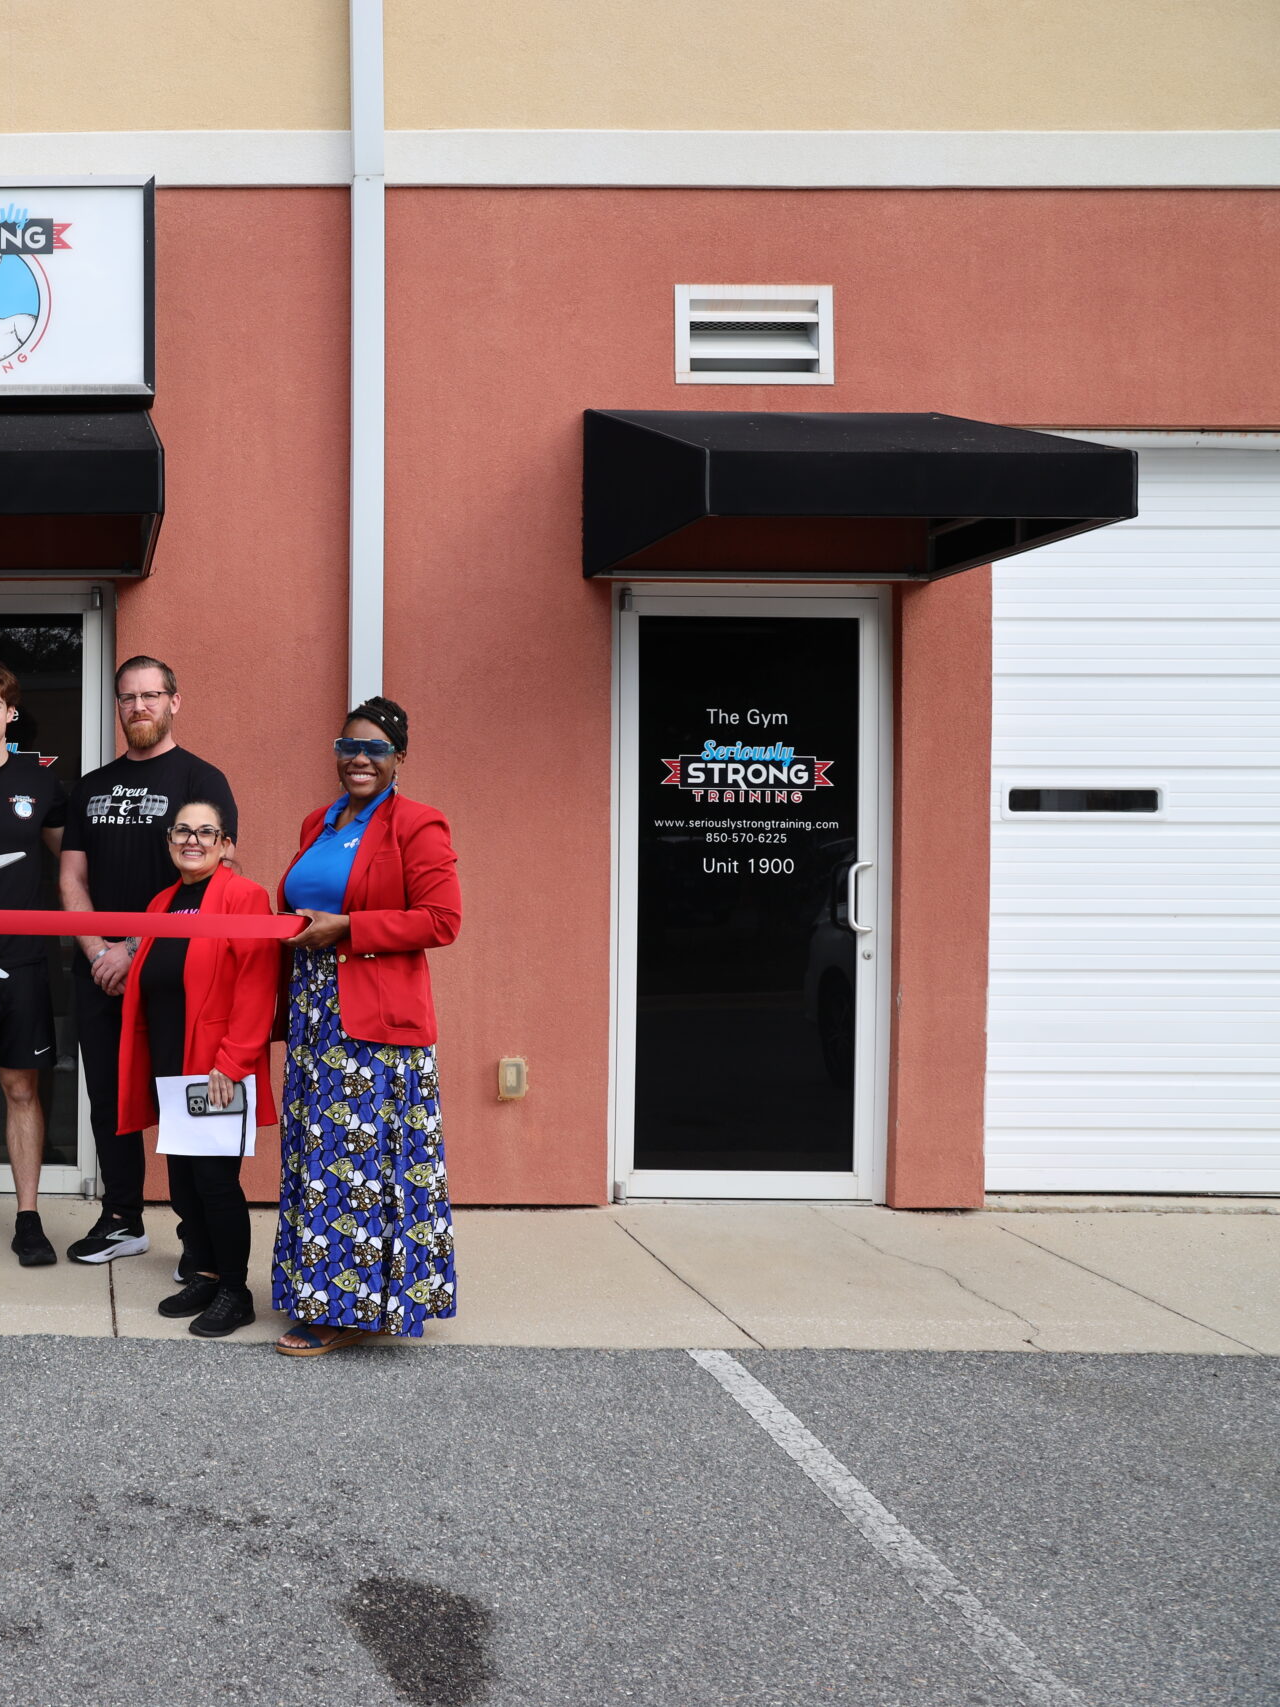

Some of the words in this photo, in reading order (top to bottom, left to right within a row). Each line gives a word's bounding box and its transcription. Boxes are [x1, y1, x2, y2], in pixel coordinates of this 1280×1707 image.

[706, 708, 740, 725] The
[747, 708, 788, 728] Gym
[700, 739, 795, 767] Seriously
[687, 762, 809, 789] STRONG
[692, 789, 803, 804] TRAINING
[119, 799, 135, 816] &
[92, 815, 153, 825] BARBELLS
[654, 818, 839, 831] www.seriouslystrongtraining.com
[705, 832, 787, 844] 850-570-6225
[703, 857, 739, 874] Unit
[747, 858, 795, 874] 1900
